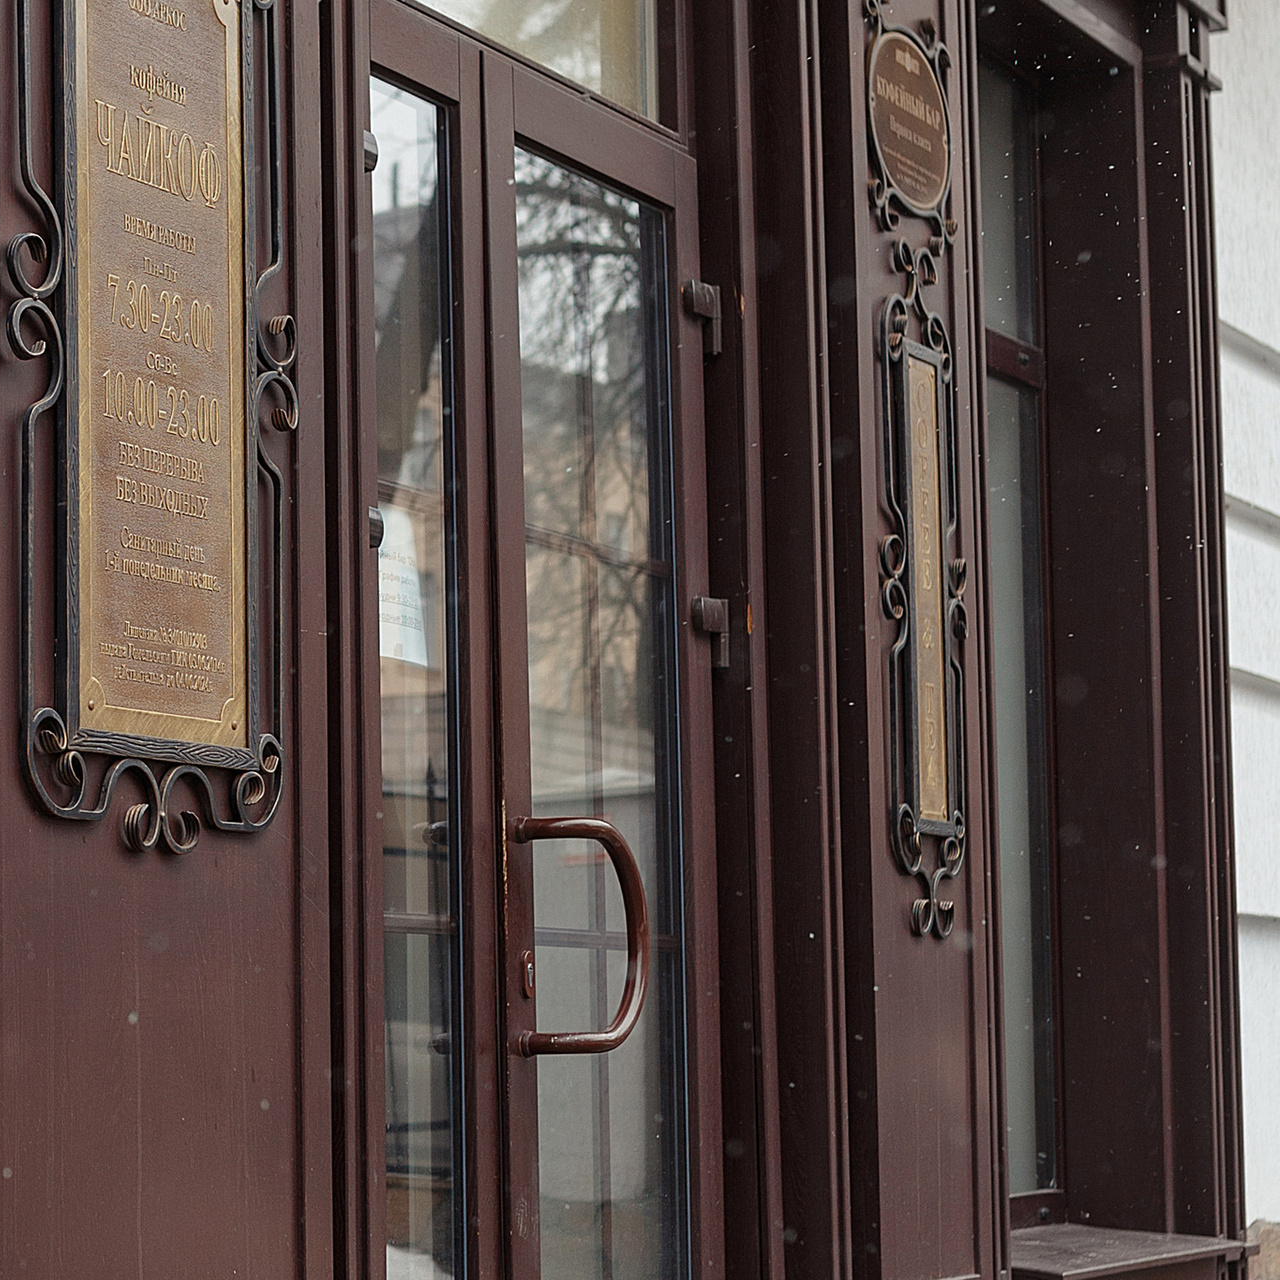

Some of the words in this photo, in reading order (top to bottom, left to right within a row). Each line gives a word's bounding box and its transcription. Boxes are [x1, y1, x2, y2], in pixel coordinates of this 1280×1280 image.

[153, 1, 187, 32] АРКОС
[876, 74, 926, 121] КОФЕЙНЫЙ
[926, 104, 941, 131] БАР
[95, 99, 221, 209] ЧАЙКОФ
[124, 213, 157, 242] ВРЕМЯ
[157, 226, 196, 255] РАБОТЫ
[143, 256, 178, 283] Пн-Пт
[107, 273, 213, 352] 7.30-23.00
[146, 351, 178, 376] Сб-Вс
[102, 369, 221, 446] 10.00-23.00
[118, 441, 140, 469] БЕЗ
[142, 447, 205, 484] ПЕРЕРЫВА
[116, 476, 138, 504] БЕЗ
[139, 482, 209, 520] ВЫХОДНЫХ
[916, 380, 933, 592] COFFEE
[120, 525, 182, 560] Санитарный
[183, 544, 206, 564] день
[121, 558, 184, 585] понедельник
[924, 682, 937, 787] TEA
